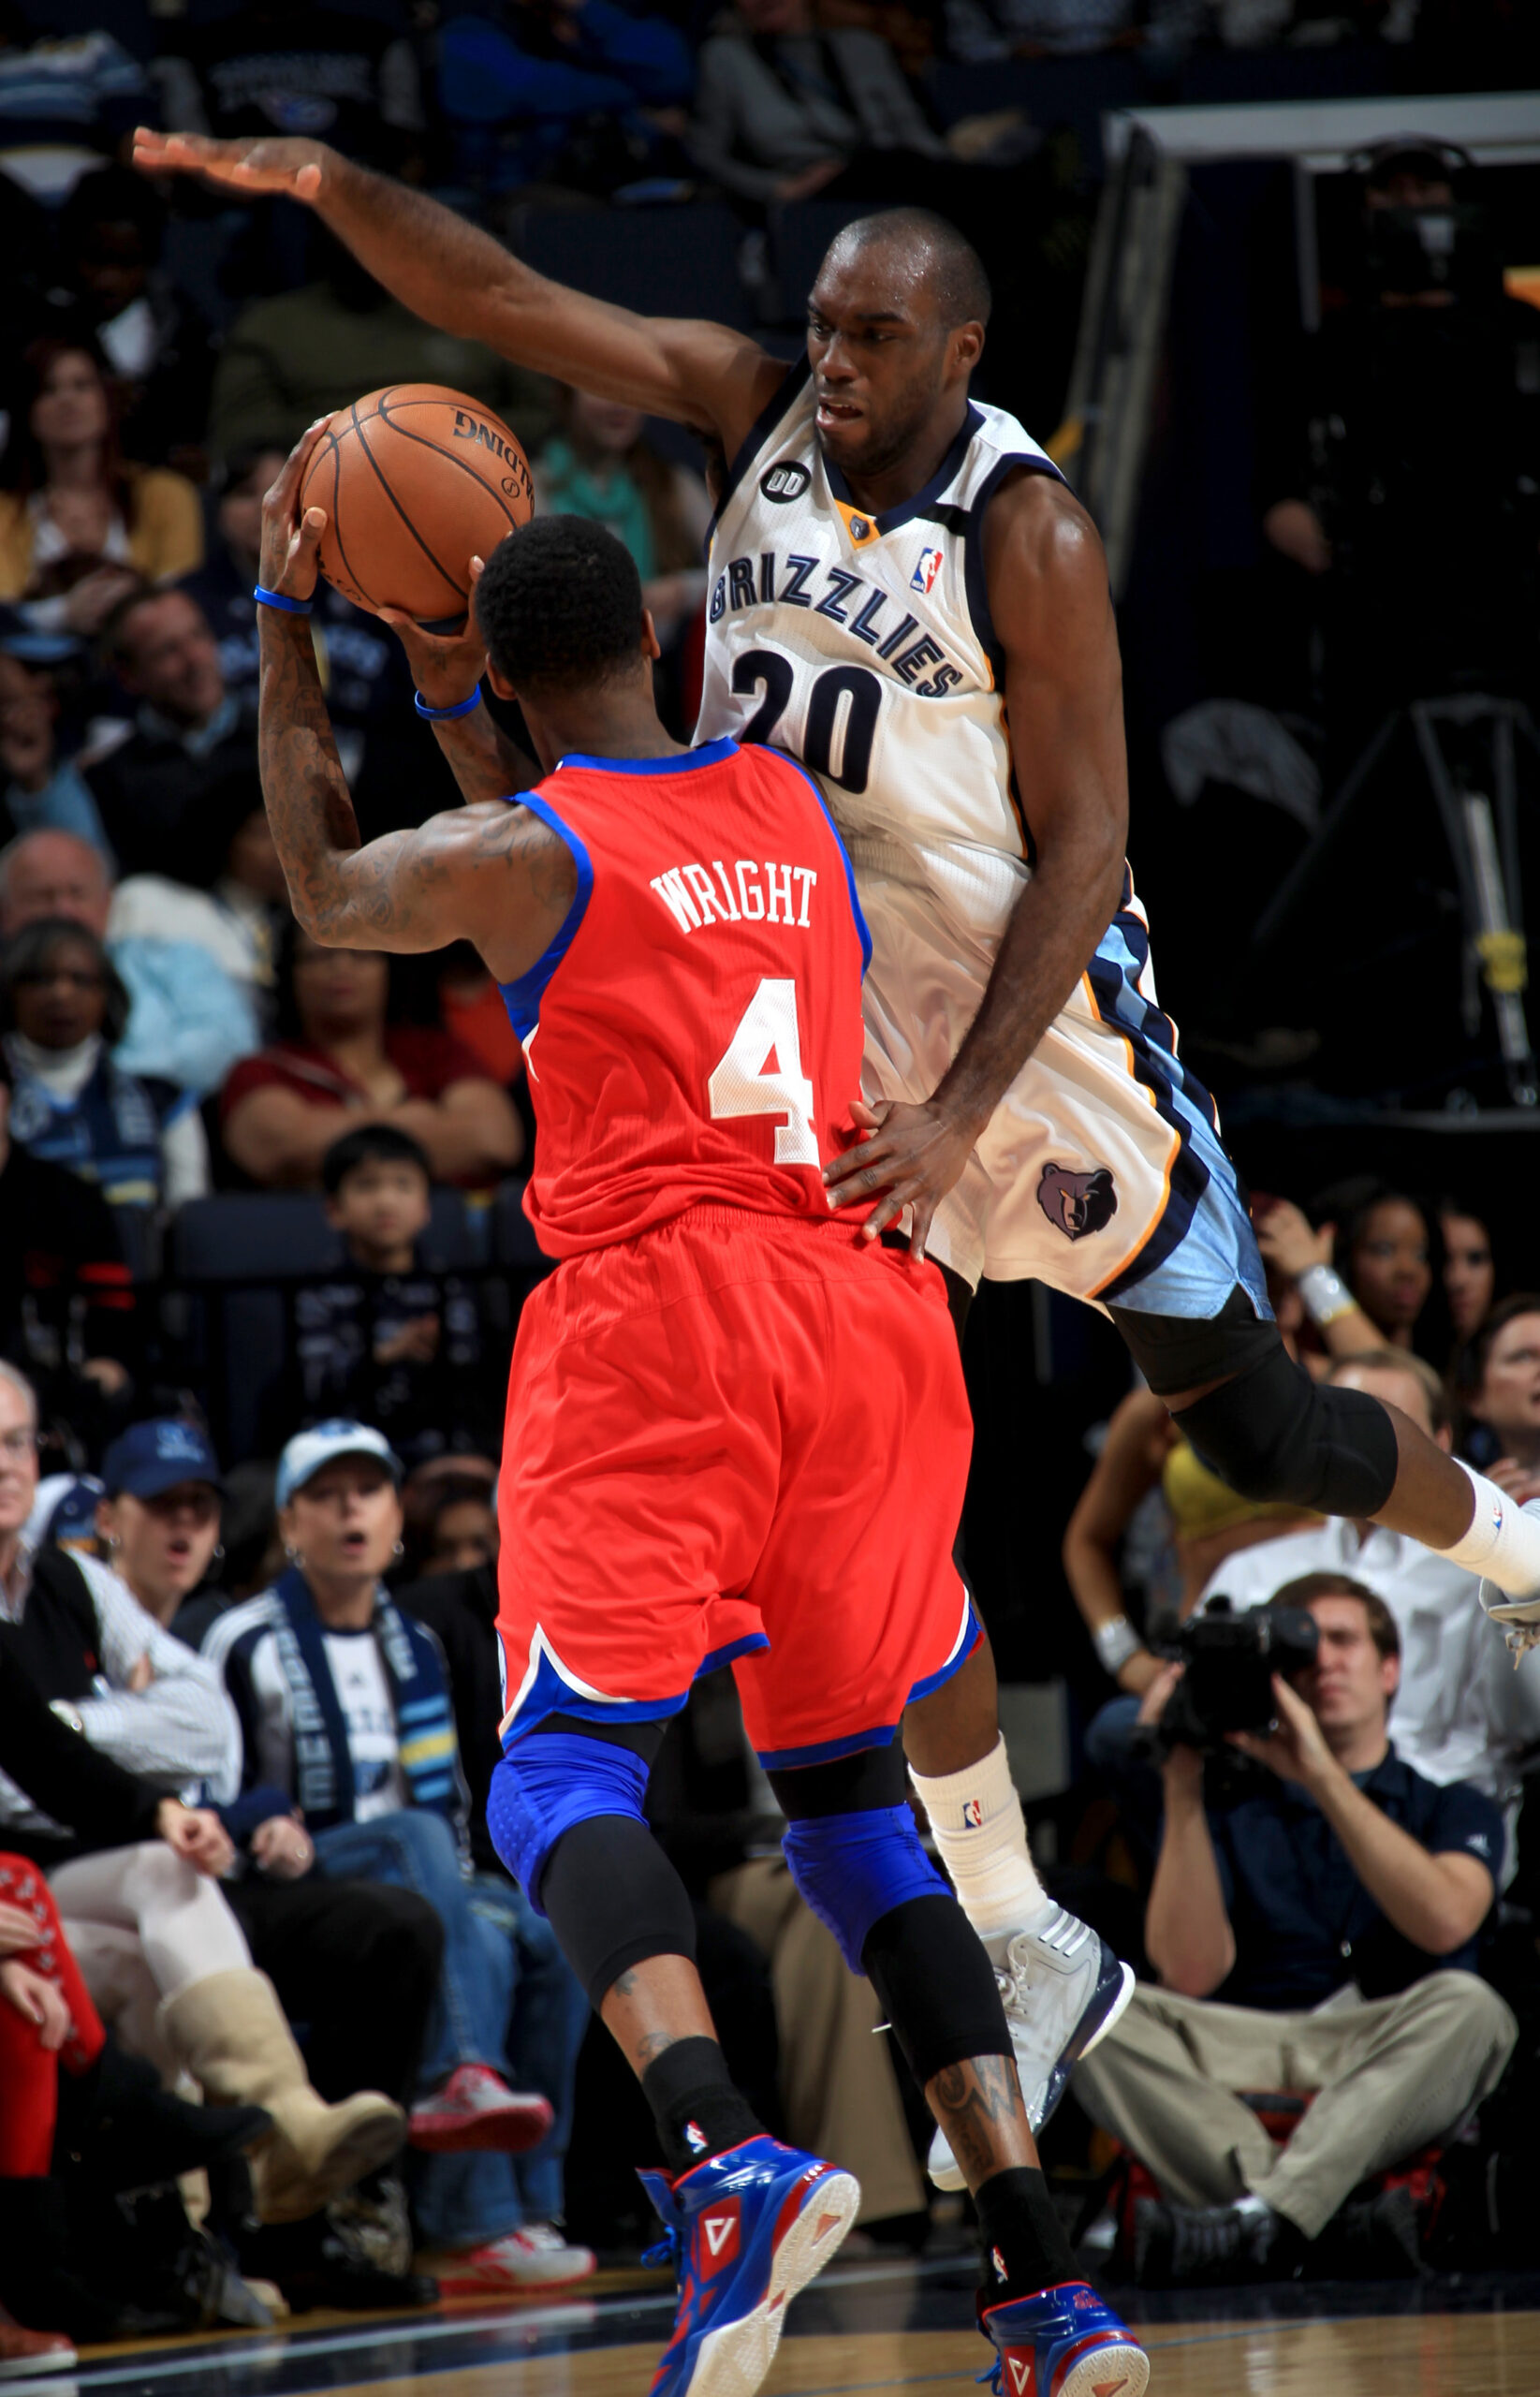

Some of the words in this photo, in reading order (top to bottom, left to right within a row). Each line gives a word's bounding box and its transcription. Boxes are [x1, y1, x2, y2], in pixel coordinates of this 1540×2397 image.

[453, 409, 535, 521] ALDING
[710, 551, 963, 698] GRIZZLIES
[732, 649, 883, 795] 20
[650, 860, 817, 934] WRIGHT
[708, 978, 822, 1169] 4
